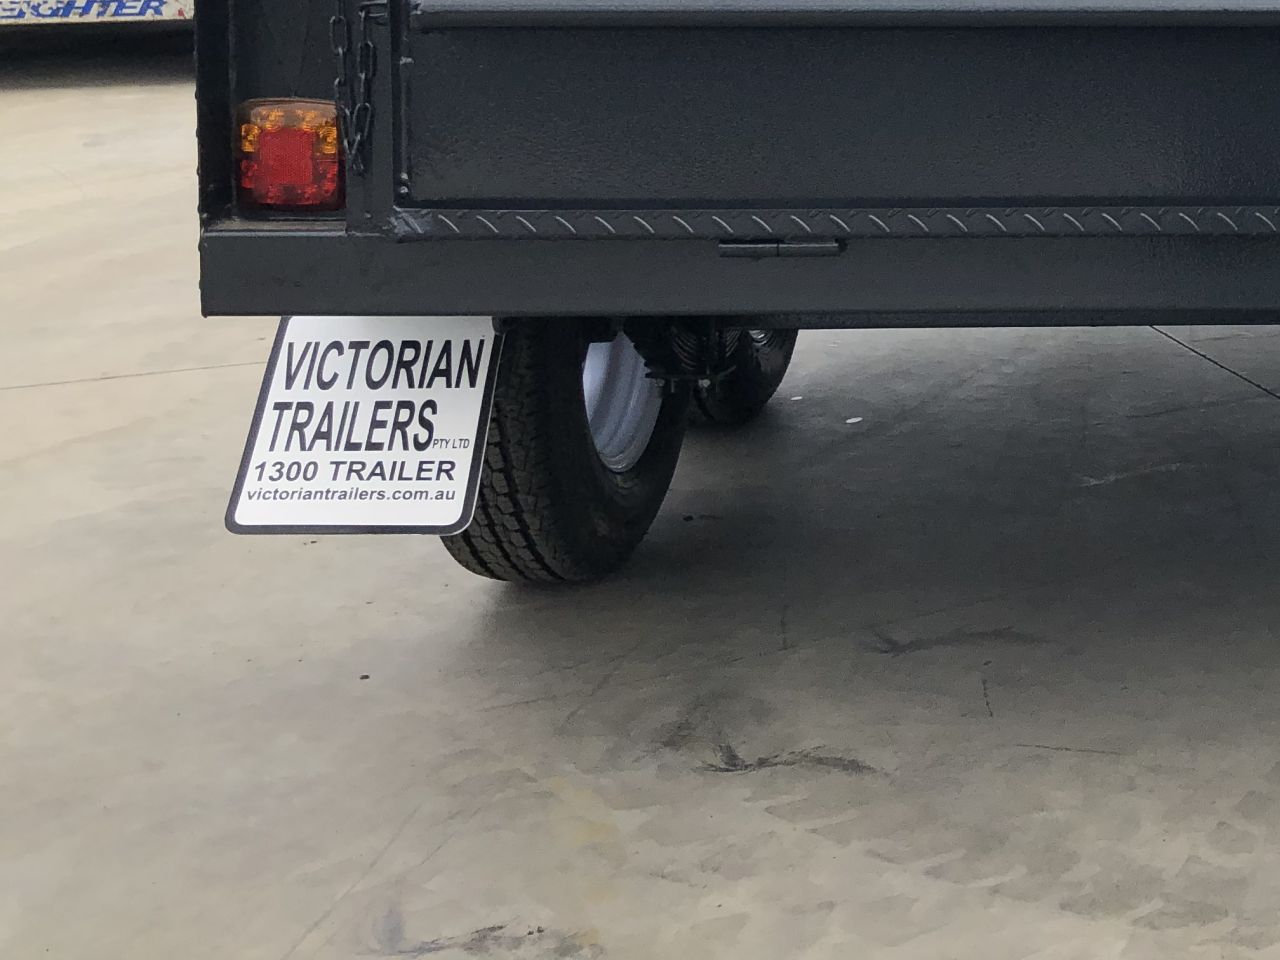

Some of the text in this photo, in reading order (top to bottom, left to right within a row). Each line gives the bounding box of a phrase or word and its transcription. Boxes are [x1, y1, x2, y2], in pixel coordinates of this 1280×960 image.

[284, 338, 486, 391] VICTORIAN
[268, 399, 470, 452] TRAILERS PTY LTD
[254, 460, 457, 482] 1300 TRAILER
[246, 487, 456, 501] victoriantrailers.com.au
